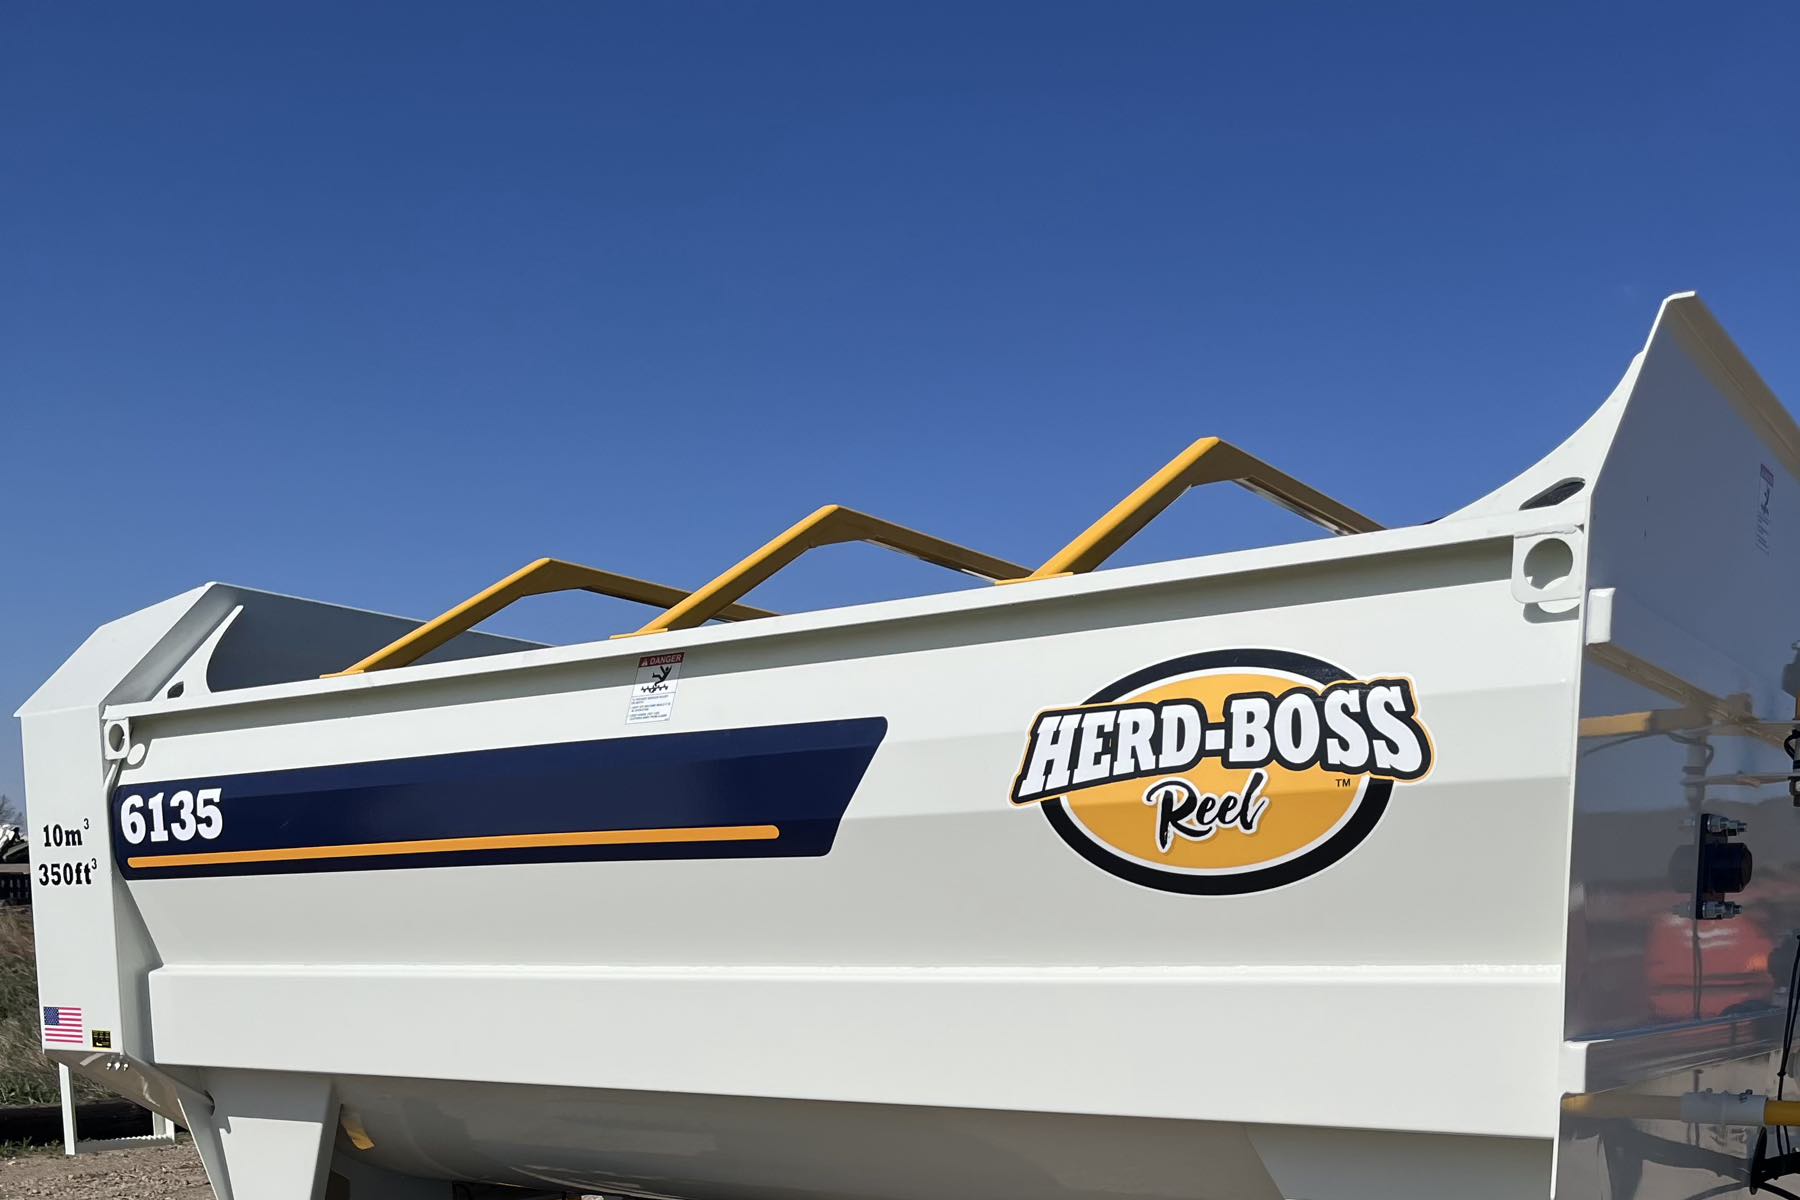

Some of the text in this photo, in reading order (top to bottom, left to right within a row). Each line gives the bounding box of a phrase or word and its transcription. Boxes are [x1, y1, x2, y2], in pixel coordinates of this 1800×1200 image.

[650, 655, 681, 665] DANGER
[1017, 685, 1423, 798] HERD-BOSS
[120, 787, 224, 845] 6135
[1148, 771, 1268, 850] Reel
